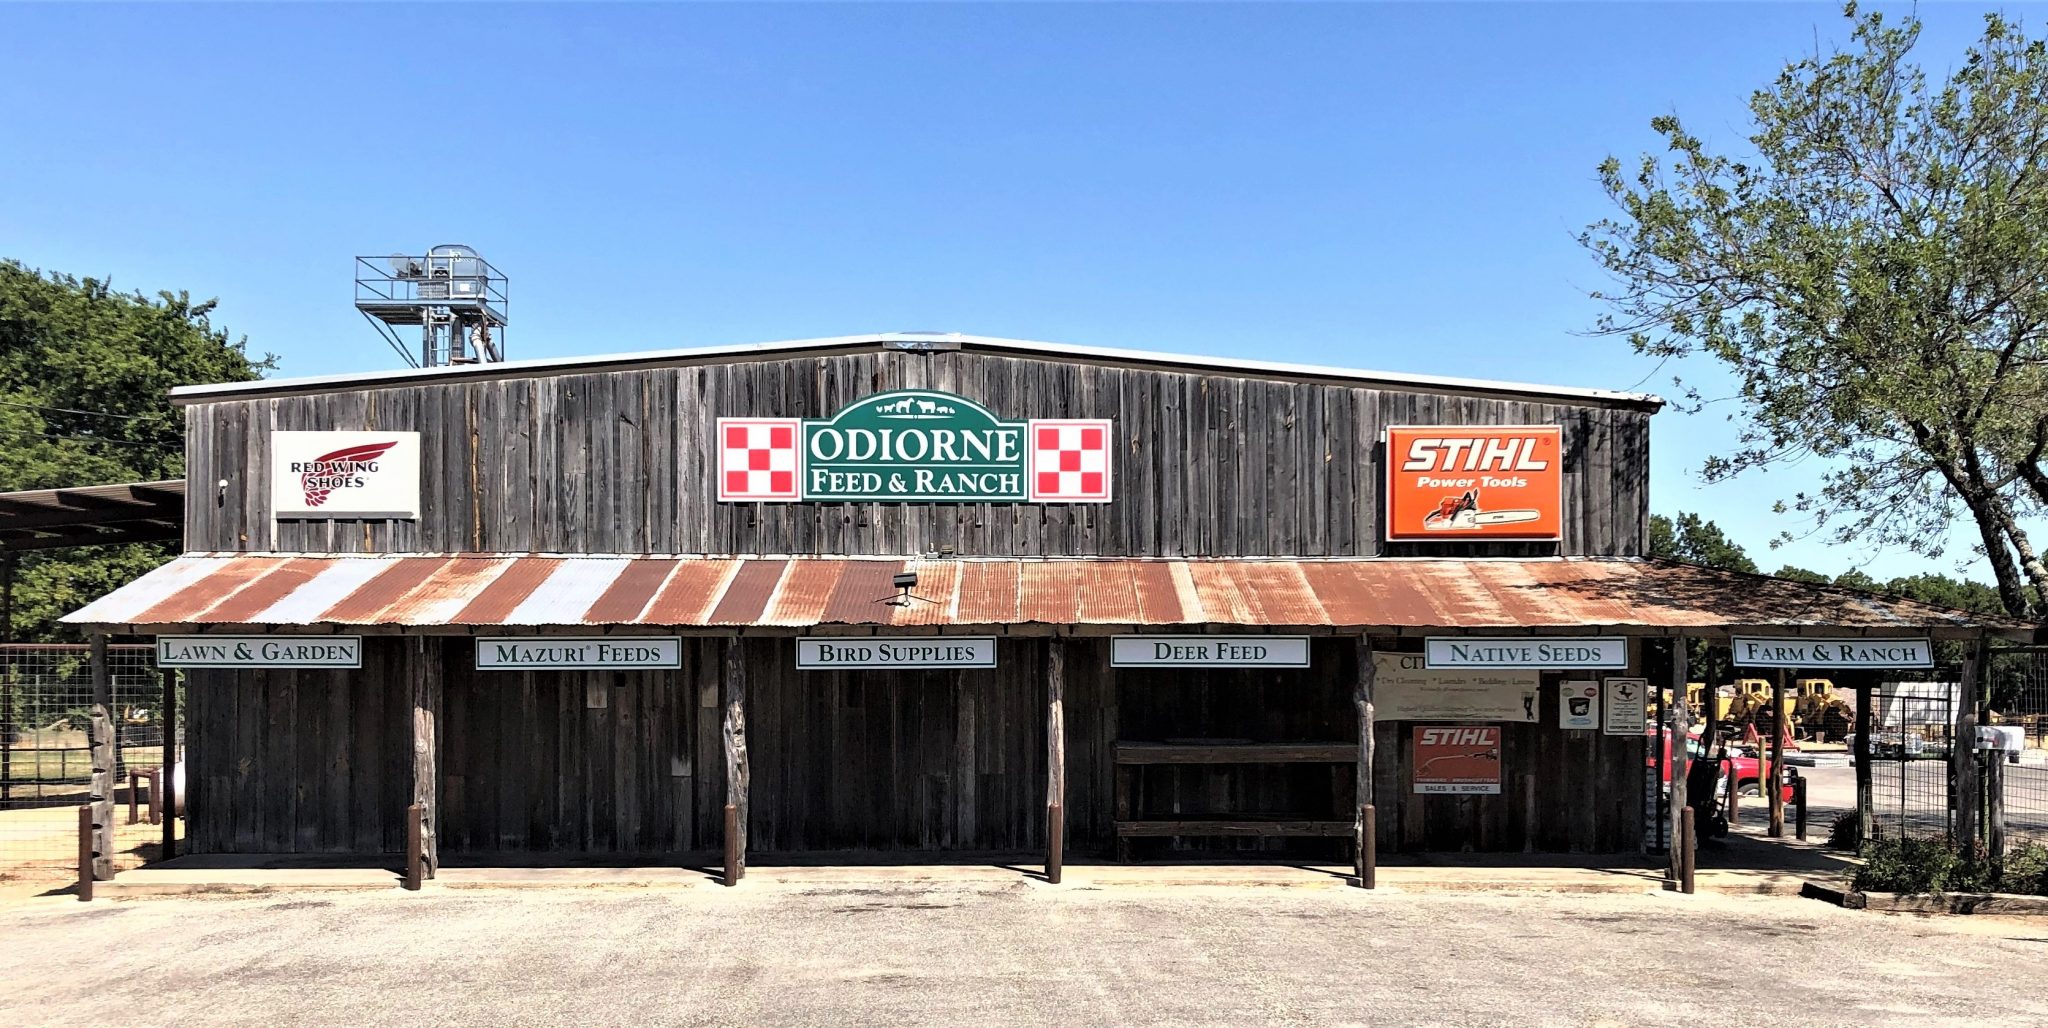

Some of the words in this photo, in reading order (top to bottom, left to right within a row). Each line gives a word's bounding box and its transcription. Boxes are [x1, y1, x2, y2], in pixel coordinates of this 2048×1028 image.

[810, 428, 1019, 462] ODIORNE
[1401, 437, 1549, 472] STIHL
[291, 462, 325, 473] RED
[331, 461, 379, 473] WING
[307, 477, 365, 488] SHOES
[811, 468, 882, 493] FEED
[888, 471, 907, 493] &
[914, 468, 1019, 494] RANCH
[1416, 476, 1475, 488] Power
[1481, 476, 1528, 488] Tools
[163, 642, 226, 662] LAWN
[233, 642, 252, 662] &
[261, 642, 355, 662] GARDEN
[597, 644, 661, 662] FEEDS
[818, 643, 872, 662] BIRD
[878, 643, 976, 663] SUPPLIES
[1153, 642, 1208, 661] DEER
[1216, 642, 1268, 661] FEED
[1450, 644, 1532, 662] NATIVE
[1538, 643, 1602, 663] SEEDS
[1746, 643, 1805, 661] FARM
[1812, 644, 1833, 662] &
[1838, 644, 1917, 662] RANCH
[1420, 729, 1494, 746] STIHL
[1425, 785, 1447, 793] SALES
[1451, 785, 1457, 793] &
[1461, 785, 1490, 793] SERVICE
